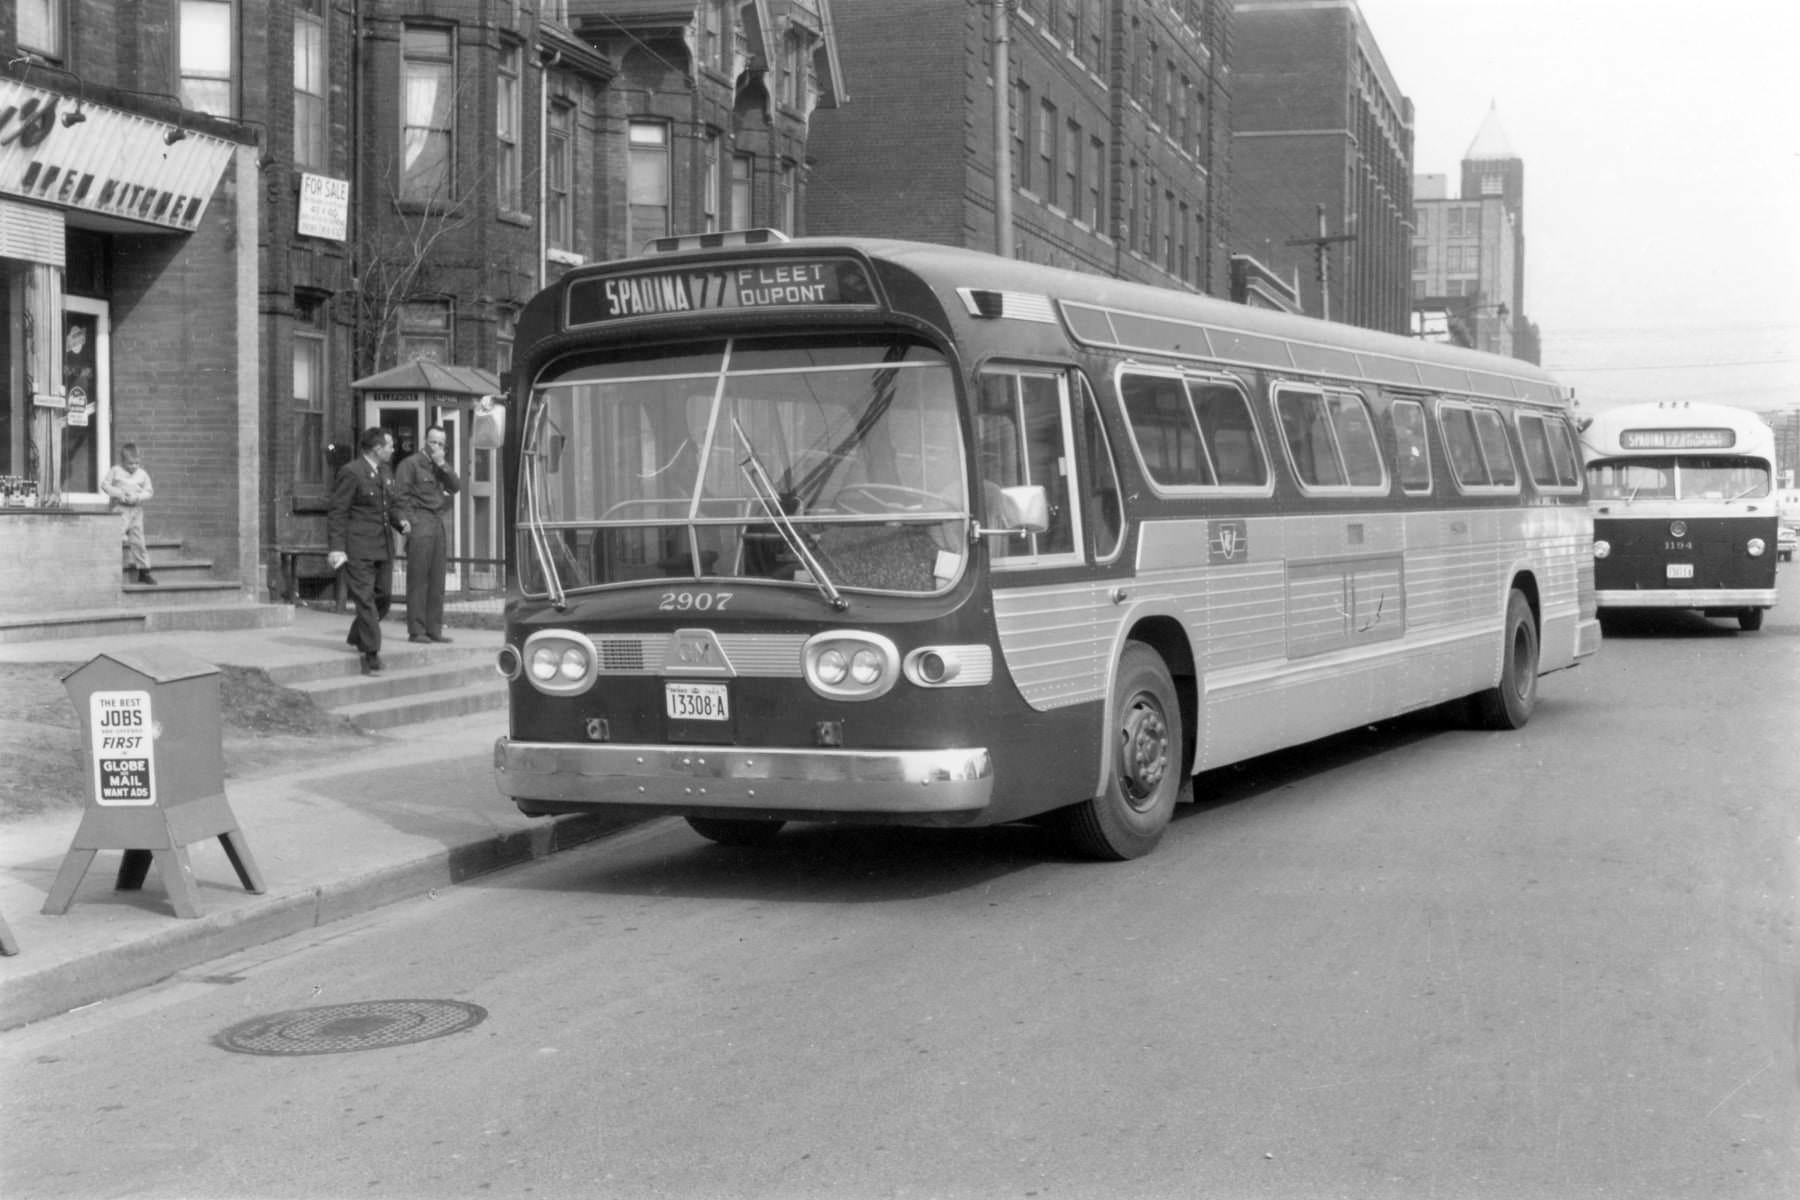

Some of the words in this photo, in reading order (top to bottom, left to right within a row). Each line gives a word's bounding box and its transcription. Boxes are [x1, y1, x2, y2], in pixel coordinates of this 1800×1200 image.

[21, 161, 95, 204] OPEN
[97, 179, 202, 226] KITCHEN
[304, 176, 322, 195] FOR
[325, 181, 346, 200] SALE
[738, 264, 823, 286] FLEET
[605, 275, 690, 315] SPADINA
[689, 272, 727, 307] 77
[741, 285, 825, 306] DUPONT
[658, 592, 733, 611] 2907
[101, 699, 115, 707] THE
[120, 698, 141, 707] BEST
[101, 710, 142, 726] JOBS
[103, 737, 144, 749] FIRST
[103, 761, 146, 772] GLOBE
[110, 775, 142, 786] MAIL
[104, 788, 129, 798] WANT
[131, 788, 148, 797] ADS
